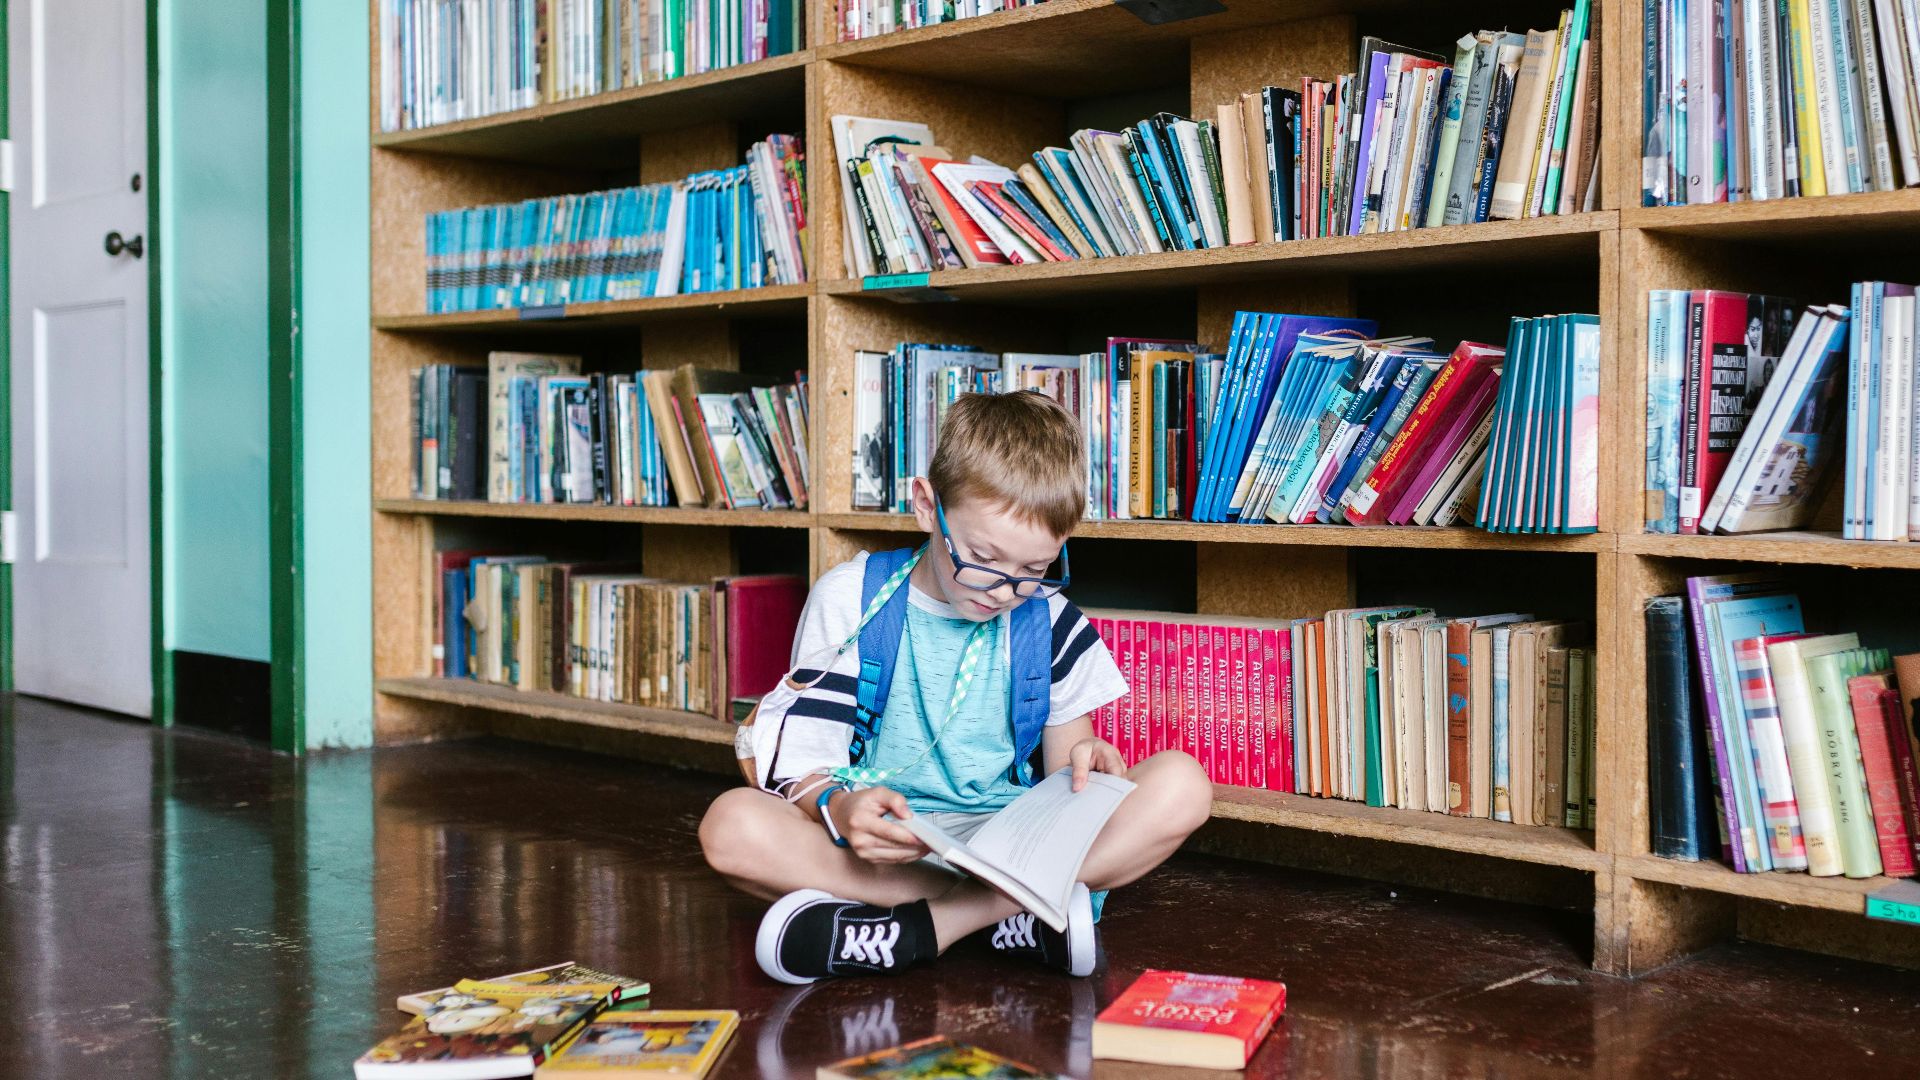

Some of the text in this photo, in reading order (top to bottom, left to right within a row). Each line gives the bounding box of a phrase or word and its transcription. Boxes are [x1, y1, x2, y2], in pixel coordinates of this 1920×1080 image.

[1867, 62, 1874, 71] OF
[1478, 162, 1493, 217] DIANE HOH
[1224, 345, 1233, 362] Many
[1250, 360, 1256, 370] Me
[1215, 387, 1224, 403] Many
[1244, 371, 1253, 389] Again
[1389, 370, 1422, 421] TO VICTORY
[1416, 362, 1454, 417] Holiday Crafts
[1236, 390, 1248, 419] Tomorrow
[1344, 391, 1364, 420] MEXICAN
[1395, 393, 1417, 424] FLIGHT
[1689, 380, 1699, 412] Dictionary
[1710, 390, 1745, 415] HISPANIC
[1211, 405, 1220, 424] Voices
[1356, 446, 1366, 458] PAN
[1687, 423, 1697, 451] Hispanic
[1686, 453, 1696, 485] Americans
[1138, 650, 1148, 740] ARTEMIS FOWL
[1186, 656, 1196, 747] ARTEMIS FOWL
[1202, 656, 1212, 747] ARTEMIS FOWL
[1218, 658, 1228, 751] ARTEMIS FOWL
[1235, 660, 1246, 752] ARTEMIS FOWL
[1252, 661, 1263, 755] ARTEMIS FOWL
[1106, 706, 1114, 736] FOWL
[1123, 708, 1131, 740] FOWL
[1825, 729, 1849, 823] DOBRY WING
[1139, 1001, 1237, 1019] FOWL
